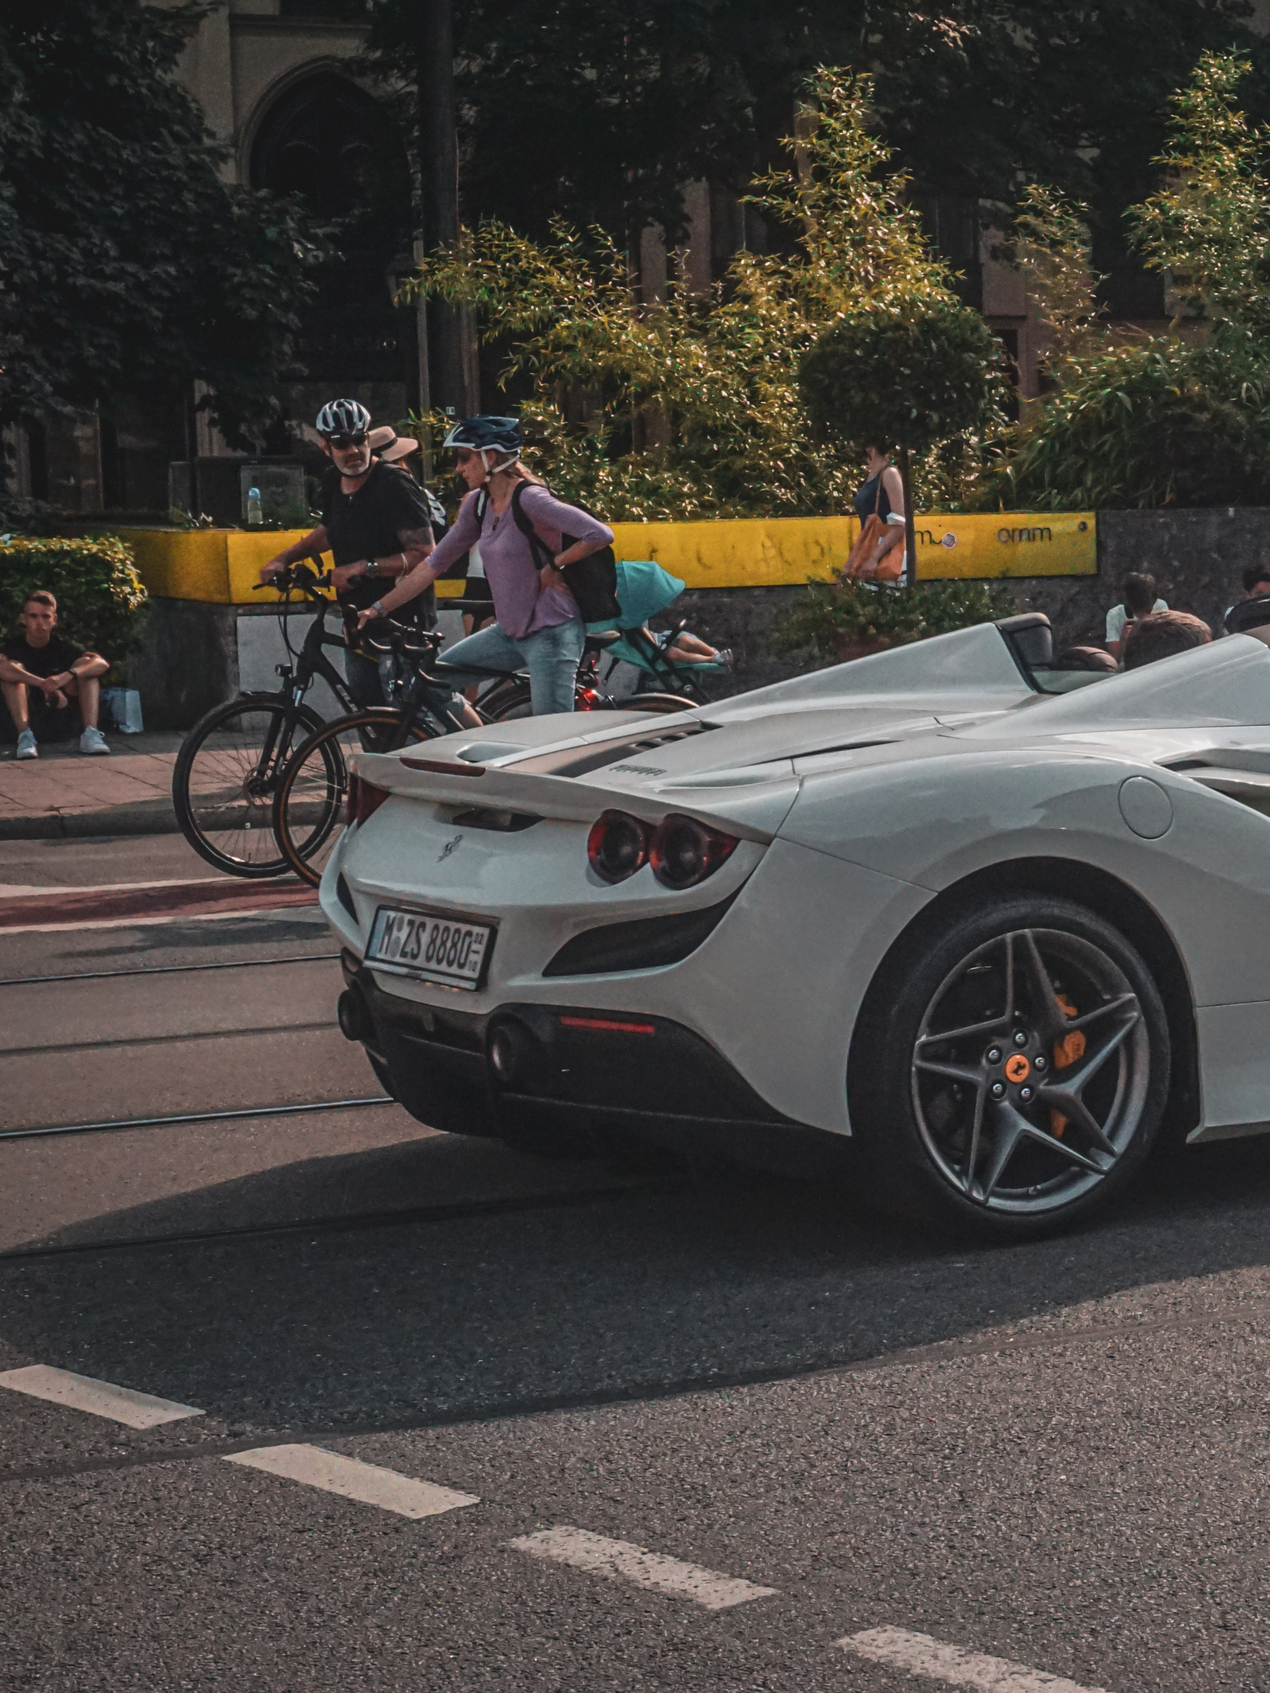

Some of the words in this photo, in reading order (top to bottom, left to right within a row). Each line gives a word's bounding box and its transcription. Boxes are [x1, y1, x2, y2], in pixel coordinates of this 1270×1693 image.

[379, 914, 398, 955] M
[400, 918, 426, 960] ZS
[425, 923, 473, 969] 8880
